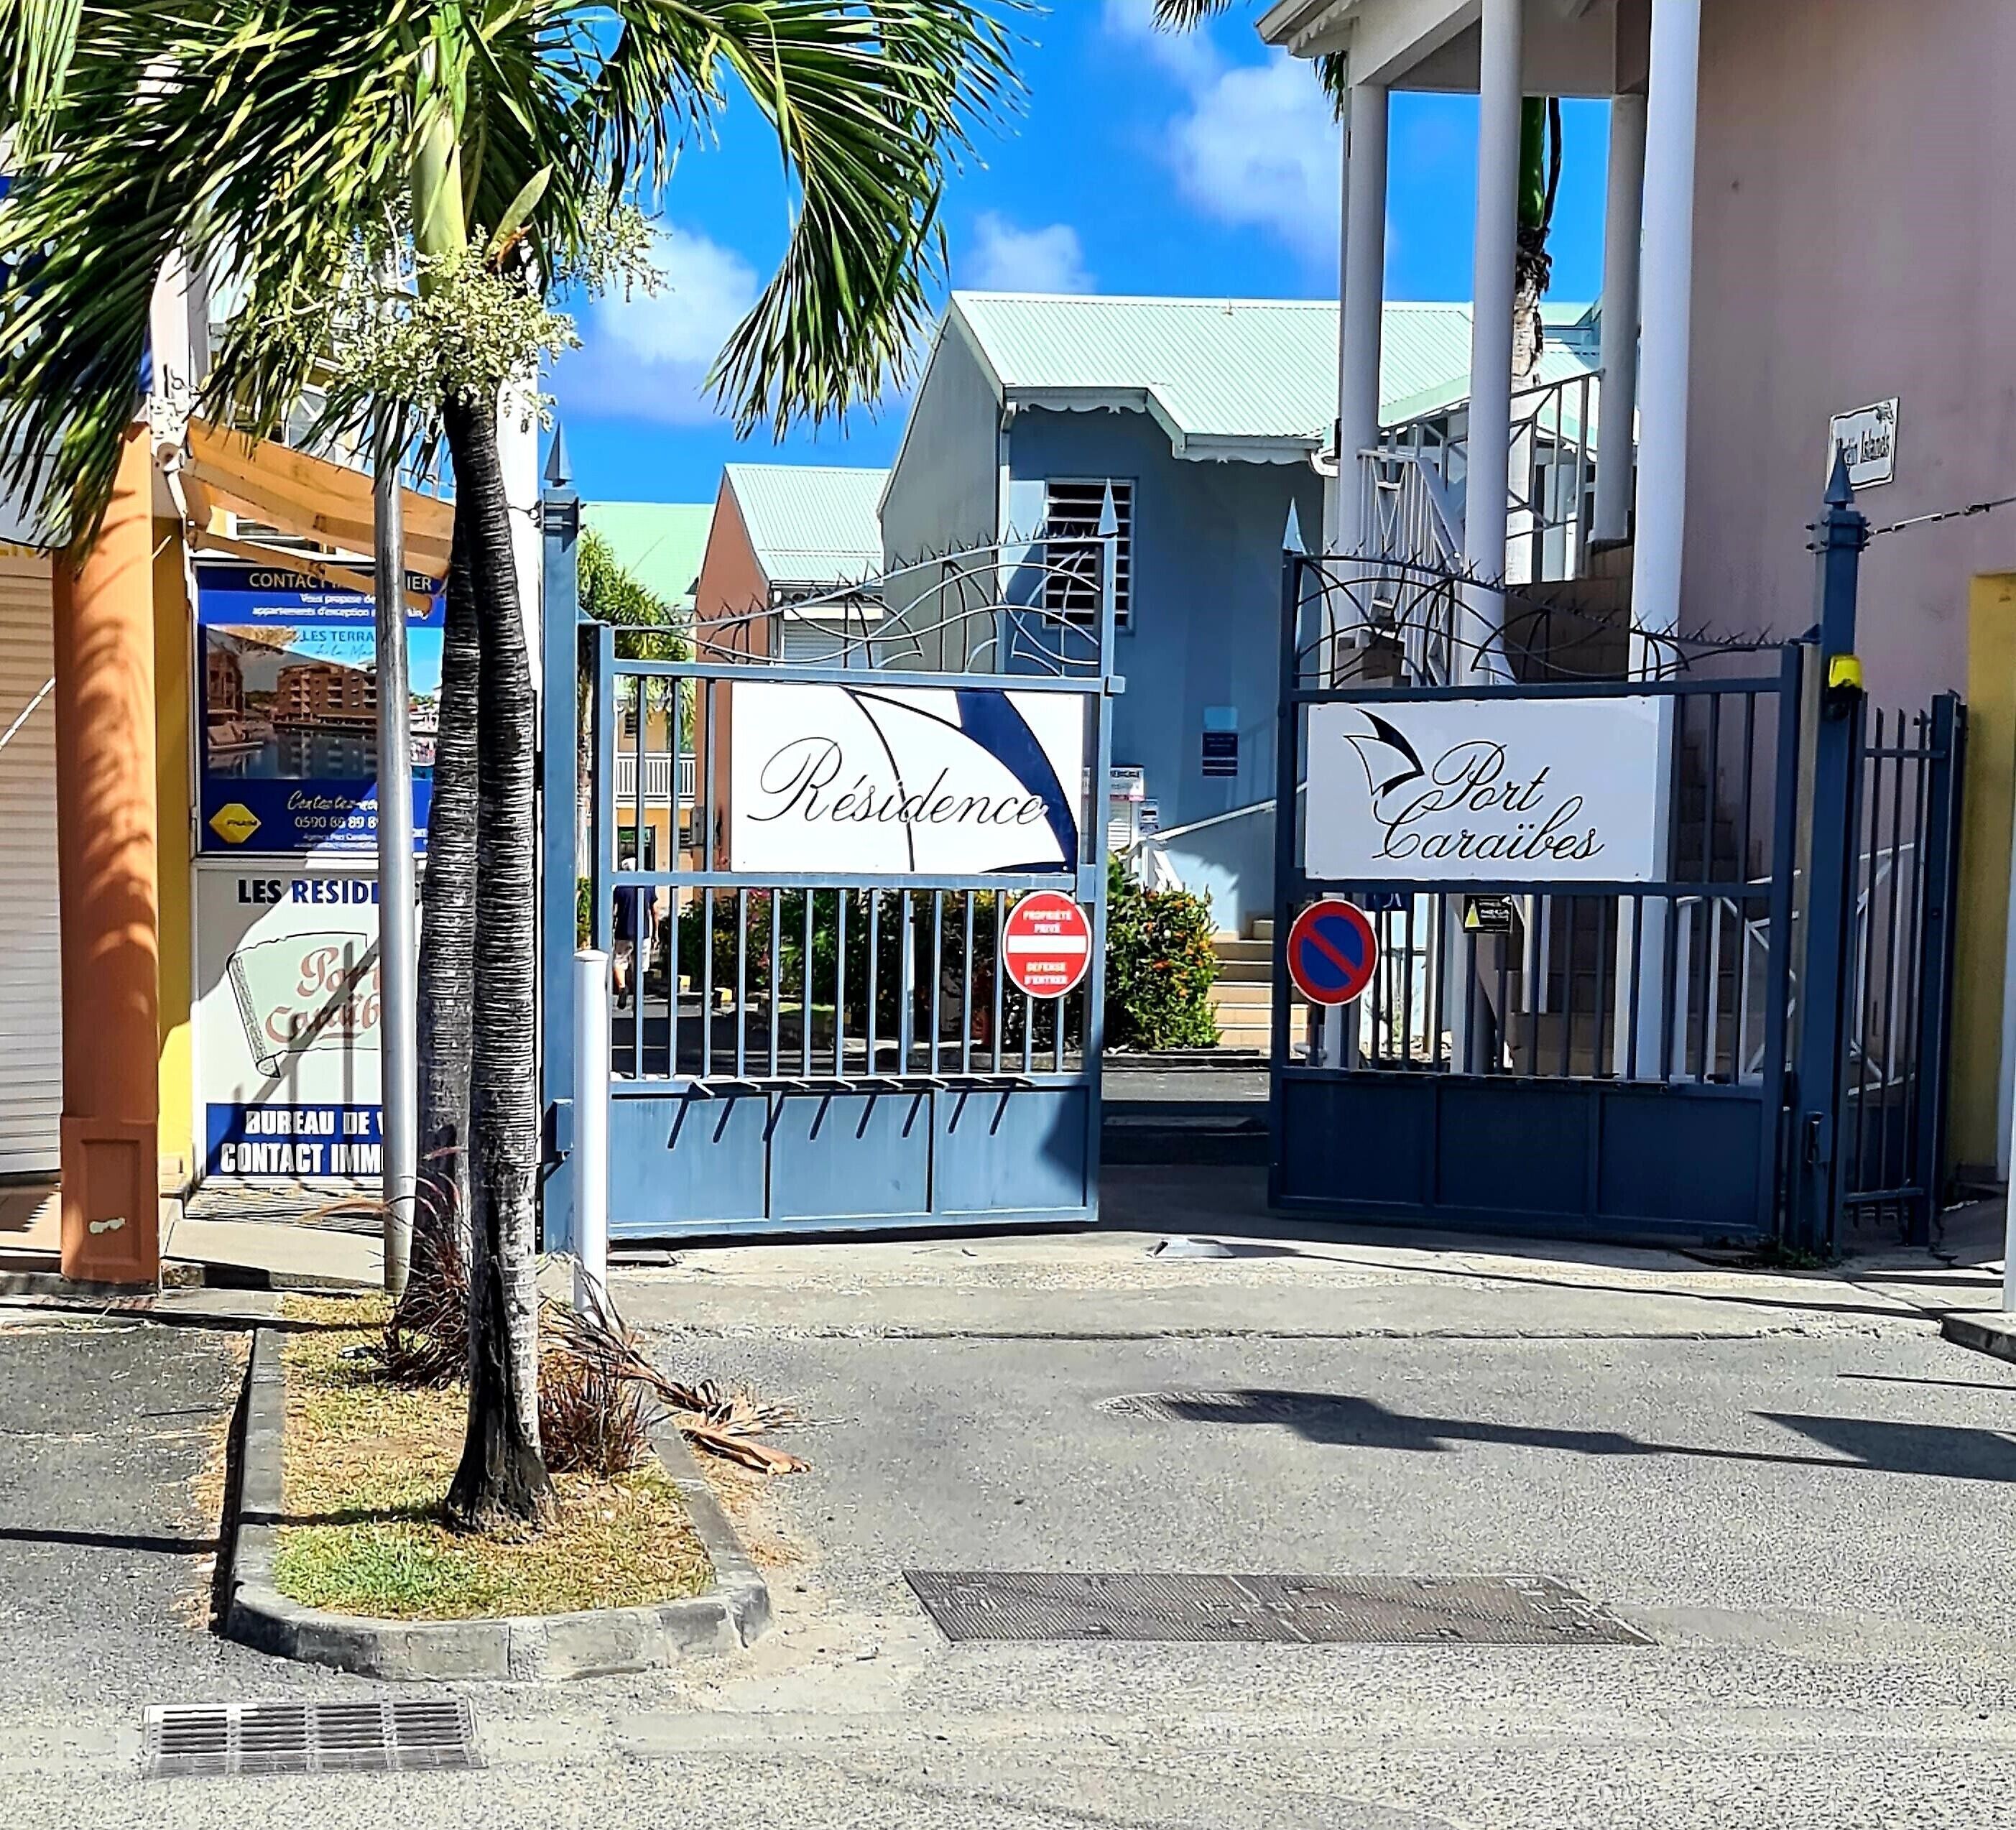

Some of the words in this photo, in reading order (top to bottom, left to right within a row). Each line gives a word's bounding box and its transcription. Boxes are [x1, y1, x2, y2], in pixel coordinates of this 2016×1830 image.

[330, 631, 375, 642] TERRA
[747, 736, 1048, 825] Résidence
[1432, 740, 1551, 812] Port
[1372, 790, 1606, 860] Caraïbes
[239, 880, 282, 903] LES
[292, 880, 379, 904] RESID
[245, 1110, 335, 1134] BUREAU
[343, 1112, 370, 1134] DE
[220, 1143, 324, 1173] CONTACT
[330, 1144, 384, 1173] IMM
